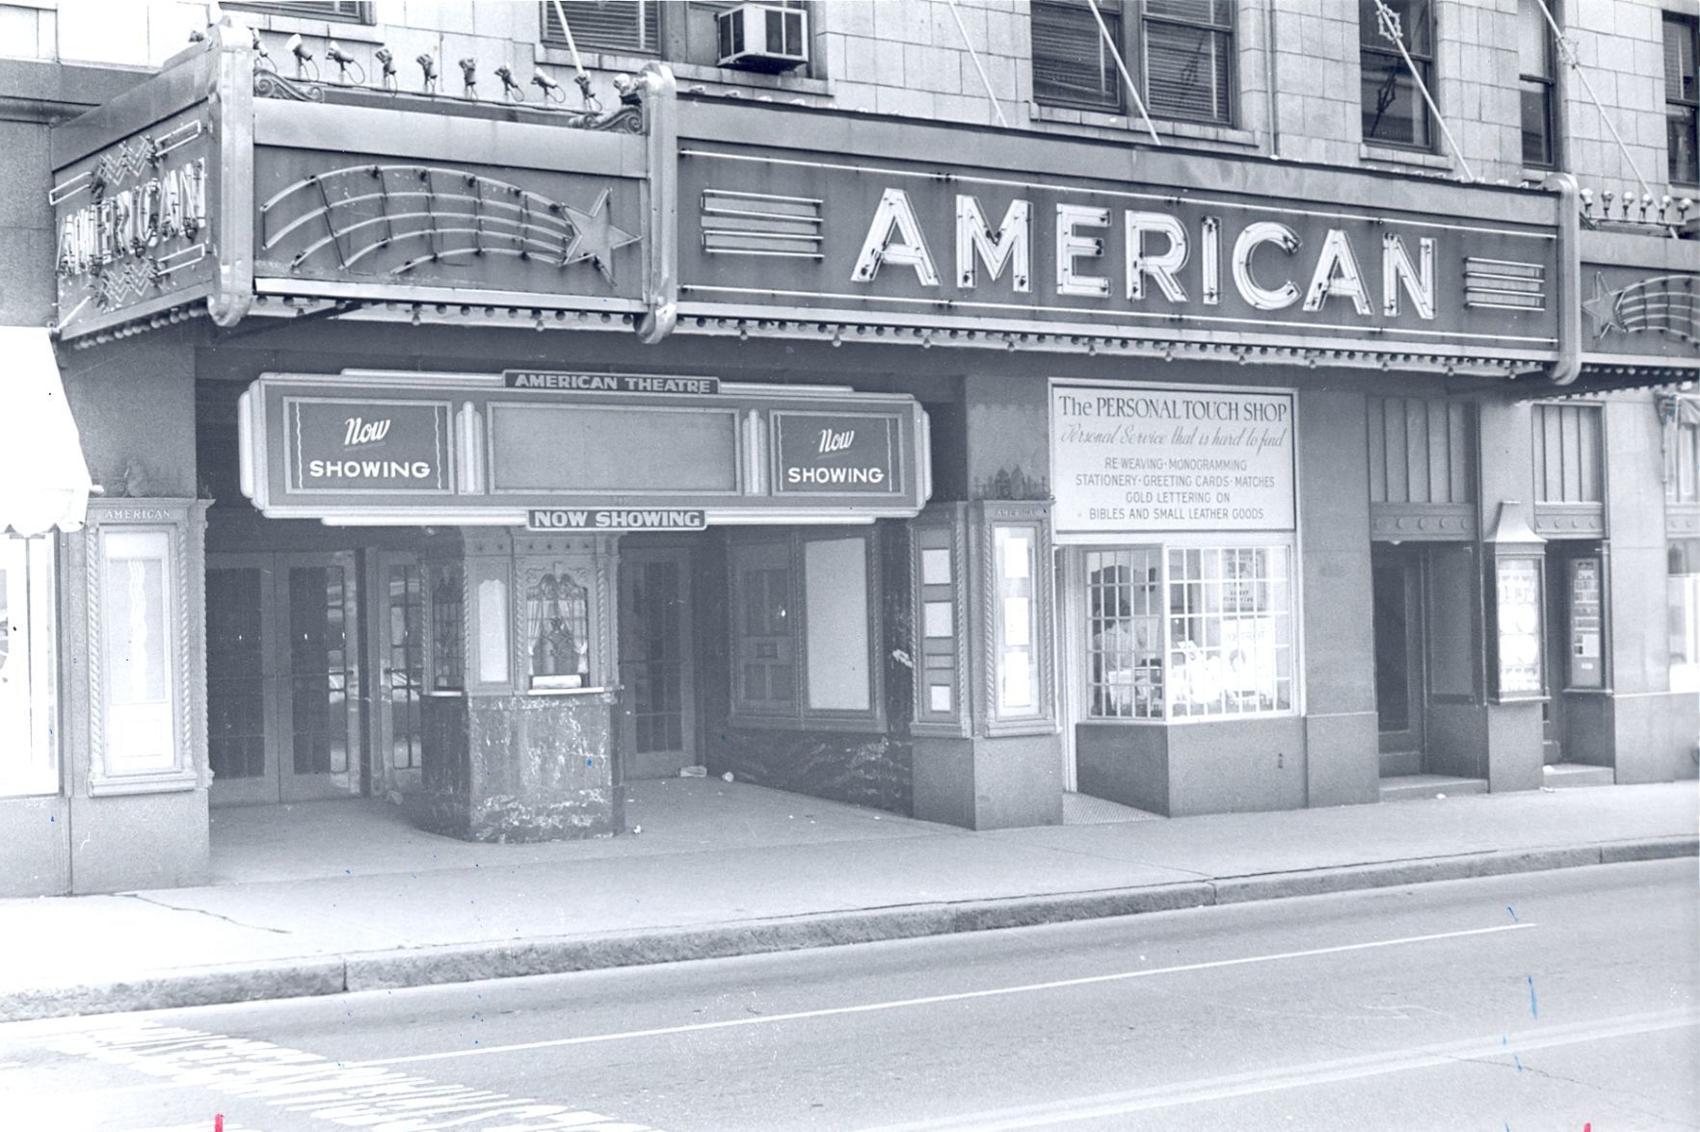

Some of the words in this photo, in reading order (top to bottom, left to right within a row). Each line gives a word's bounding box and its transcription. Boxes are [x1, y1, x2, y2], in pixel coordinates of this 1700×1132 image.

[56, 157, 207, 279] AMERICAN
[850, 186, 1438, 321] AMERICAN
[514, 372, 619, 391] AMERICAN
[624, 376, 711, 394] THEATRE
[1058, 395, 1093, 417] The
[1096, 396, 1181, 420] PERSONAL
[1182, 399, 1239, 421] TOUCH
[1243, 402, 1288, 422] SHOP
[344, 417, 391, 446] Now
[818, 428, 856, 453] Now
[1060, 423, 1122, 445] Personal
[1119, 423, 1165, 446] Service
[1170, 425, 1199, 445] that
[1198, 431, 1210, 447] is
[1210, 425, 1247, 447] hard
[1245, 427, 1258, 447] to
[1256, 427, 1288, 457] find
[309, 460, 431, 479] SHOWING
[1168, 457, 1248, 472] MONOGRAMMING
[787, 467, 885, 484] SHOWING
[1075, 473, 1138, 487] STATIONERY
[1142, 474, 1193, 488] GREETING
[1194, 474, 1230, 488] CARDS
[1234, 475, 1275, 489] MATCHES
[1125, 491, 1153, 504] GOLD
[1156, 491, 1212, 504] LETTERING
[1216, 491, 1231, 504] ON
[104, 508, 172, 521] AMERICAN
[533, 511, 588, 528] NOW
[594, 510, 701, 529] SHOWING
[1088, 506, 1126, 521] BIBLES
[1128, 507, 1150, 520] AND
[1153, 507, 1186, 520] SMALL
[1187, 507, 1230, 521] LEATHER
[1231, 507, 1265, 521] GOODS
